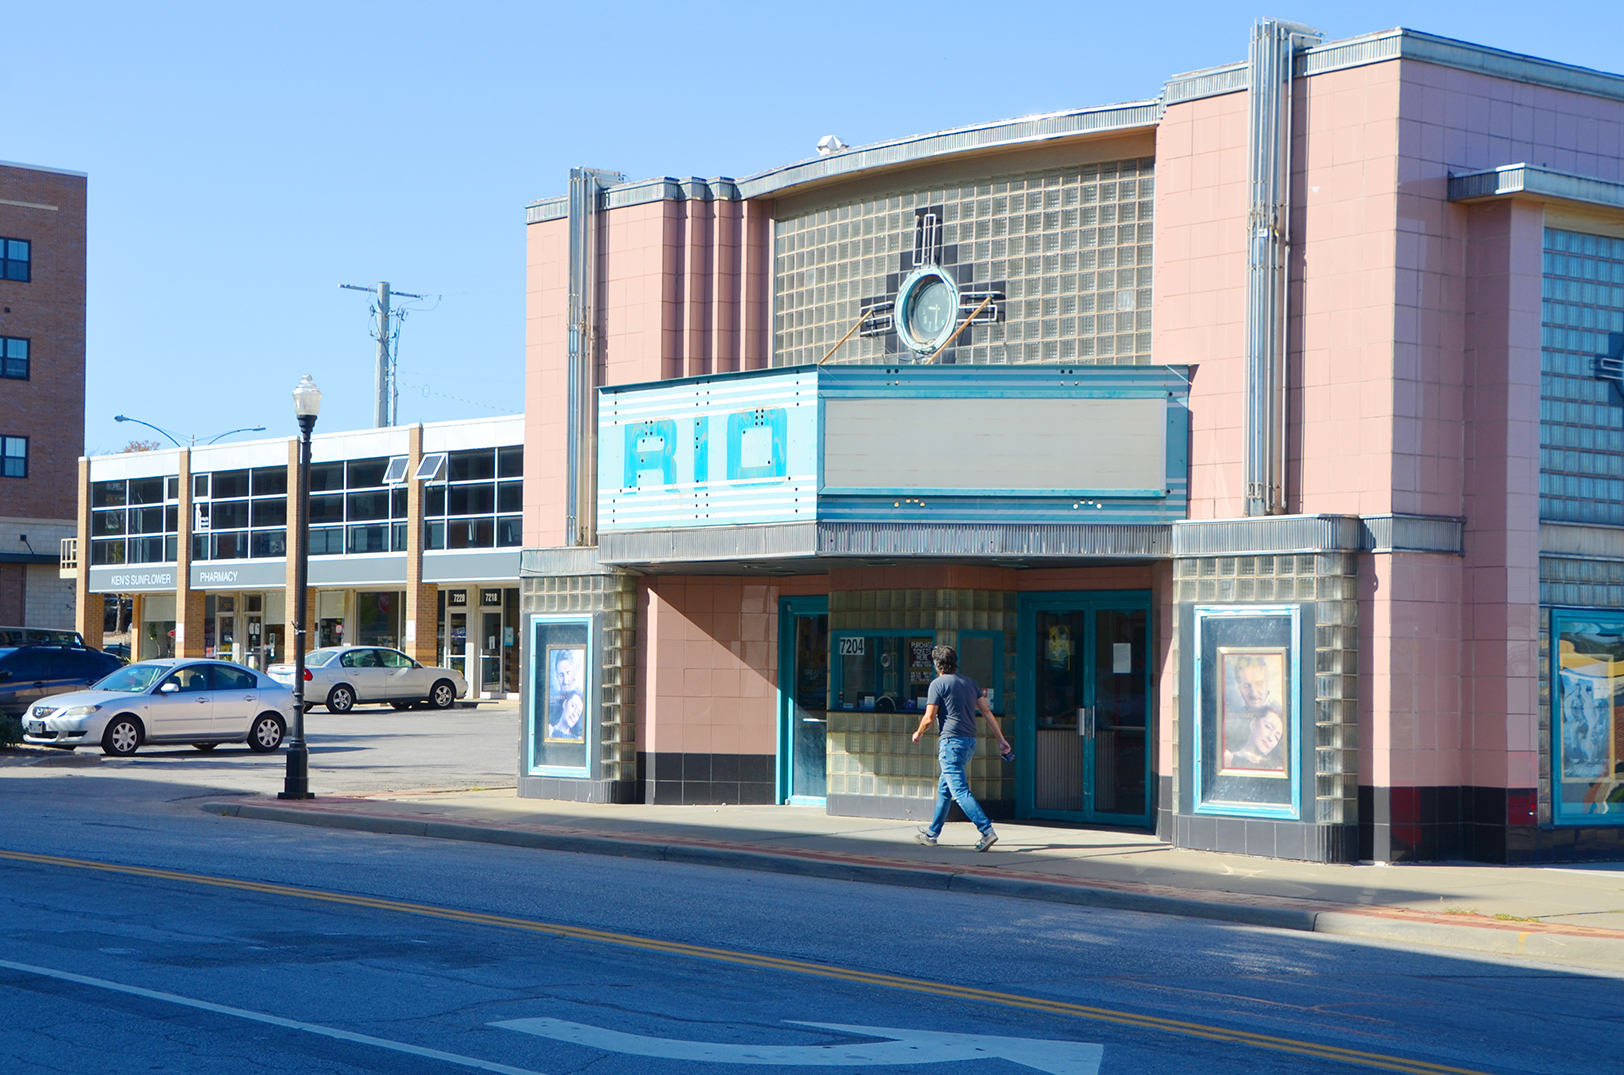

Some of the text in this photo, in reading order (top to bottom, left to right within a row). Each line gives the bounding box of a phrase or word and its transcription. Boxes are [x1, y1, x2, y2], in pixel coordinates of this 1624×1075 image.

[623, 406, 788, 495] RIO
[111, 573, 171, 585] KEN'S SUNFLOWER
[200, 571, 238, 582] PHARMACY
[840, 638, 864, 654] 7204
